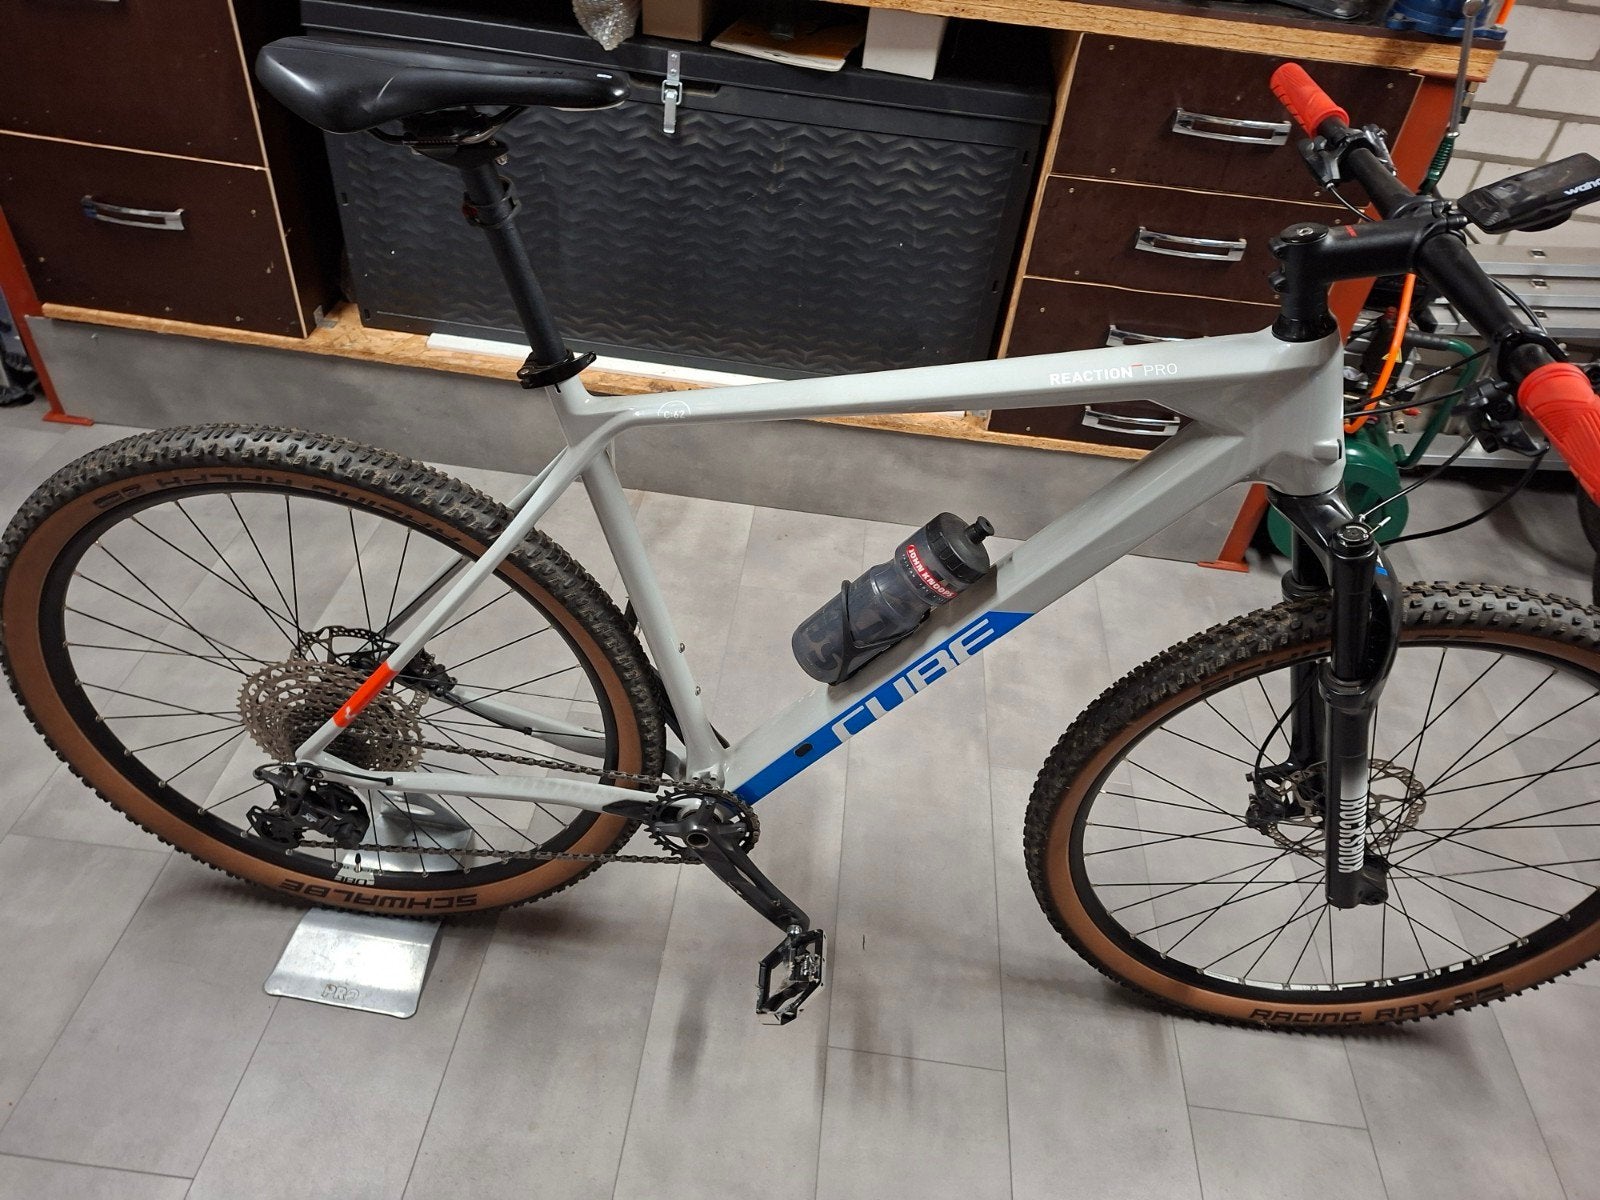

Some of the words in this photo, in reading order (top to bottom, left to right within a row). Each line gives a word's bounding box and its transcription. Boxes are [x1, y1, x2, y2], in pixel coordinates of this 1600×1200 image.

[1049, 366, 1134, 386] REACTION
[1143, 363, 1178, 377] PRO
[663, 410, 686, 419] C:62
[907, 548, 925, 573] JOHN
[921, 572, 955, 597] KNOOPS
[832, 618, 995, 743] CUBE
[1338, 795, 1368, 873] ROCKSHOX
[278, 879, 479, 909] SCHWALBE
[321, 984, 360, 1001] PRO
[1249, 1008, 1362, 1024] RACING
[1374, 1000, 1439, 1021] RAY
